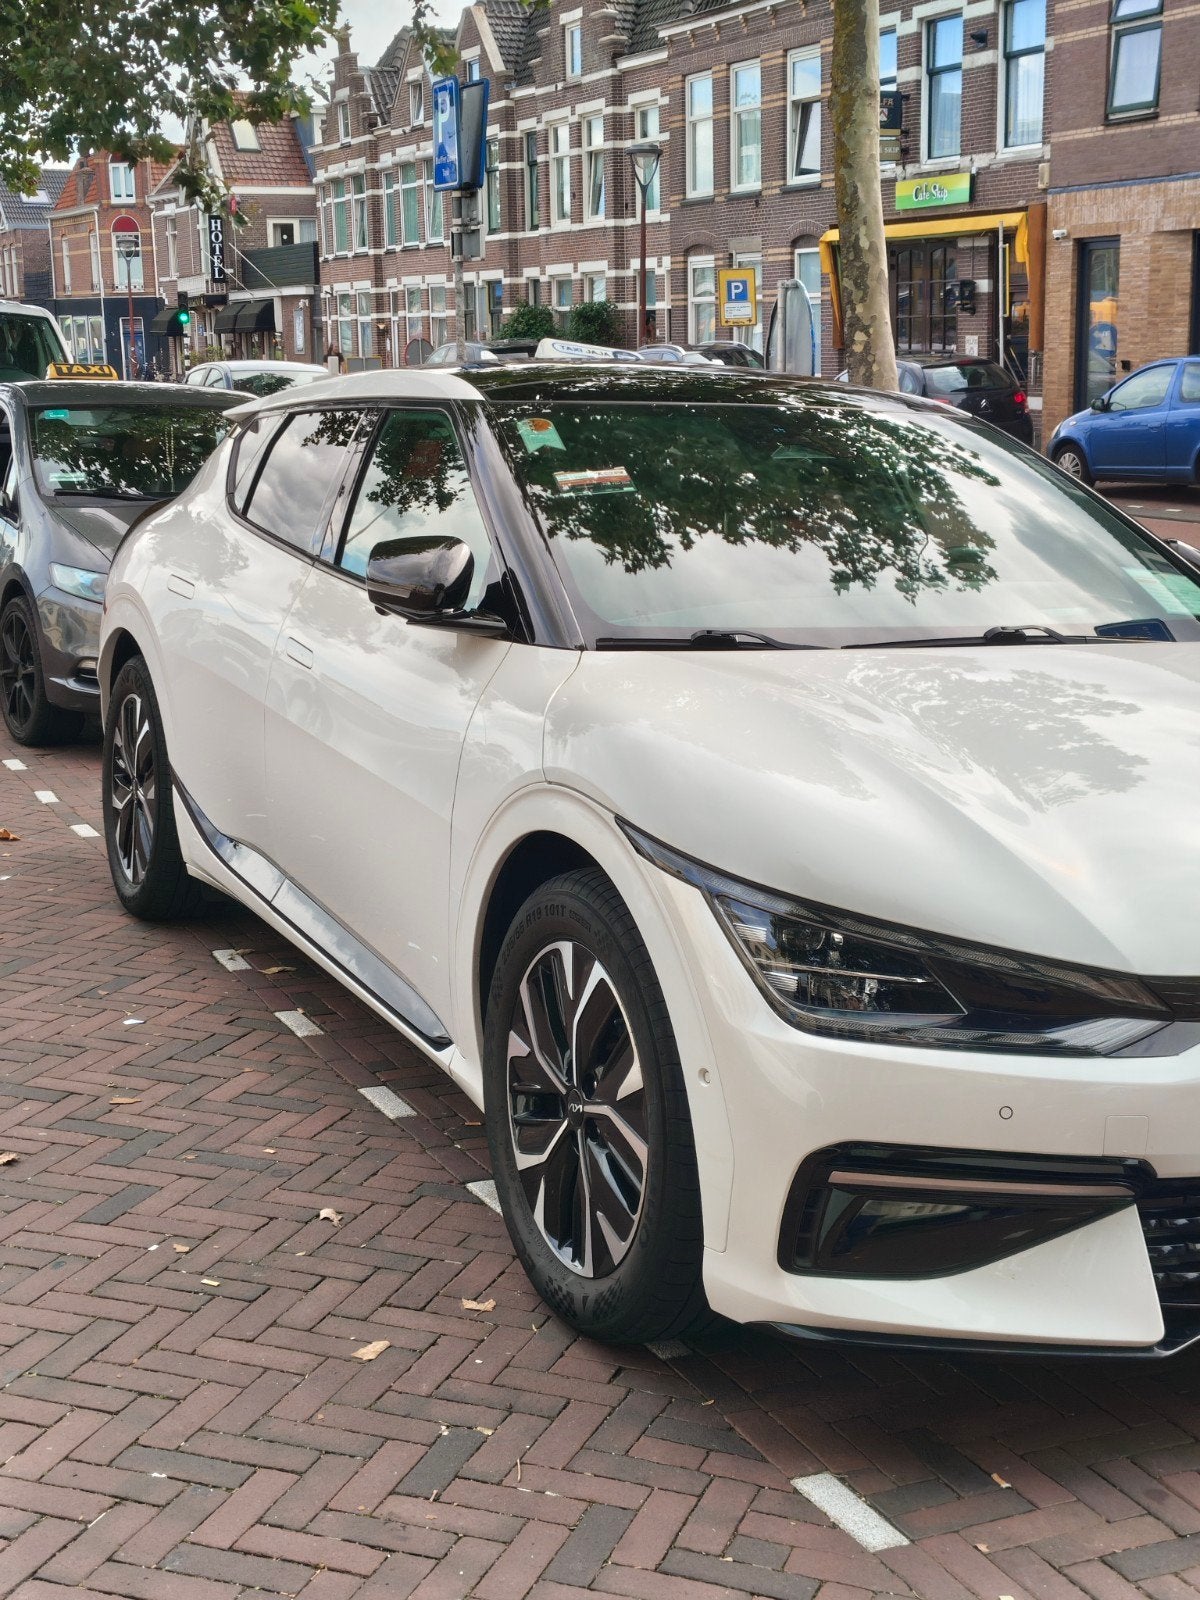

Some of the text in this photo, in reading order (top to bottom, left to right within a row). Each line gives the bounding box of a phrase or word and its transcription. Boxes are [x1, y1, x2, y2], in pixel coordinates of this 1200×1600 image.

[931, 183, 948, 202] Skip
[210, 219, 224, 279] HOTEL
[731, 282, 743, 300] P
[561, 345, 583, 354] TAXI
[56, 365, 110, 375] TAXI
